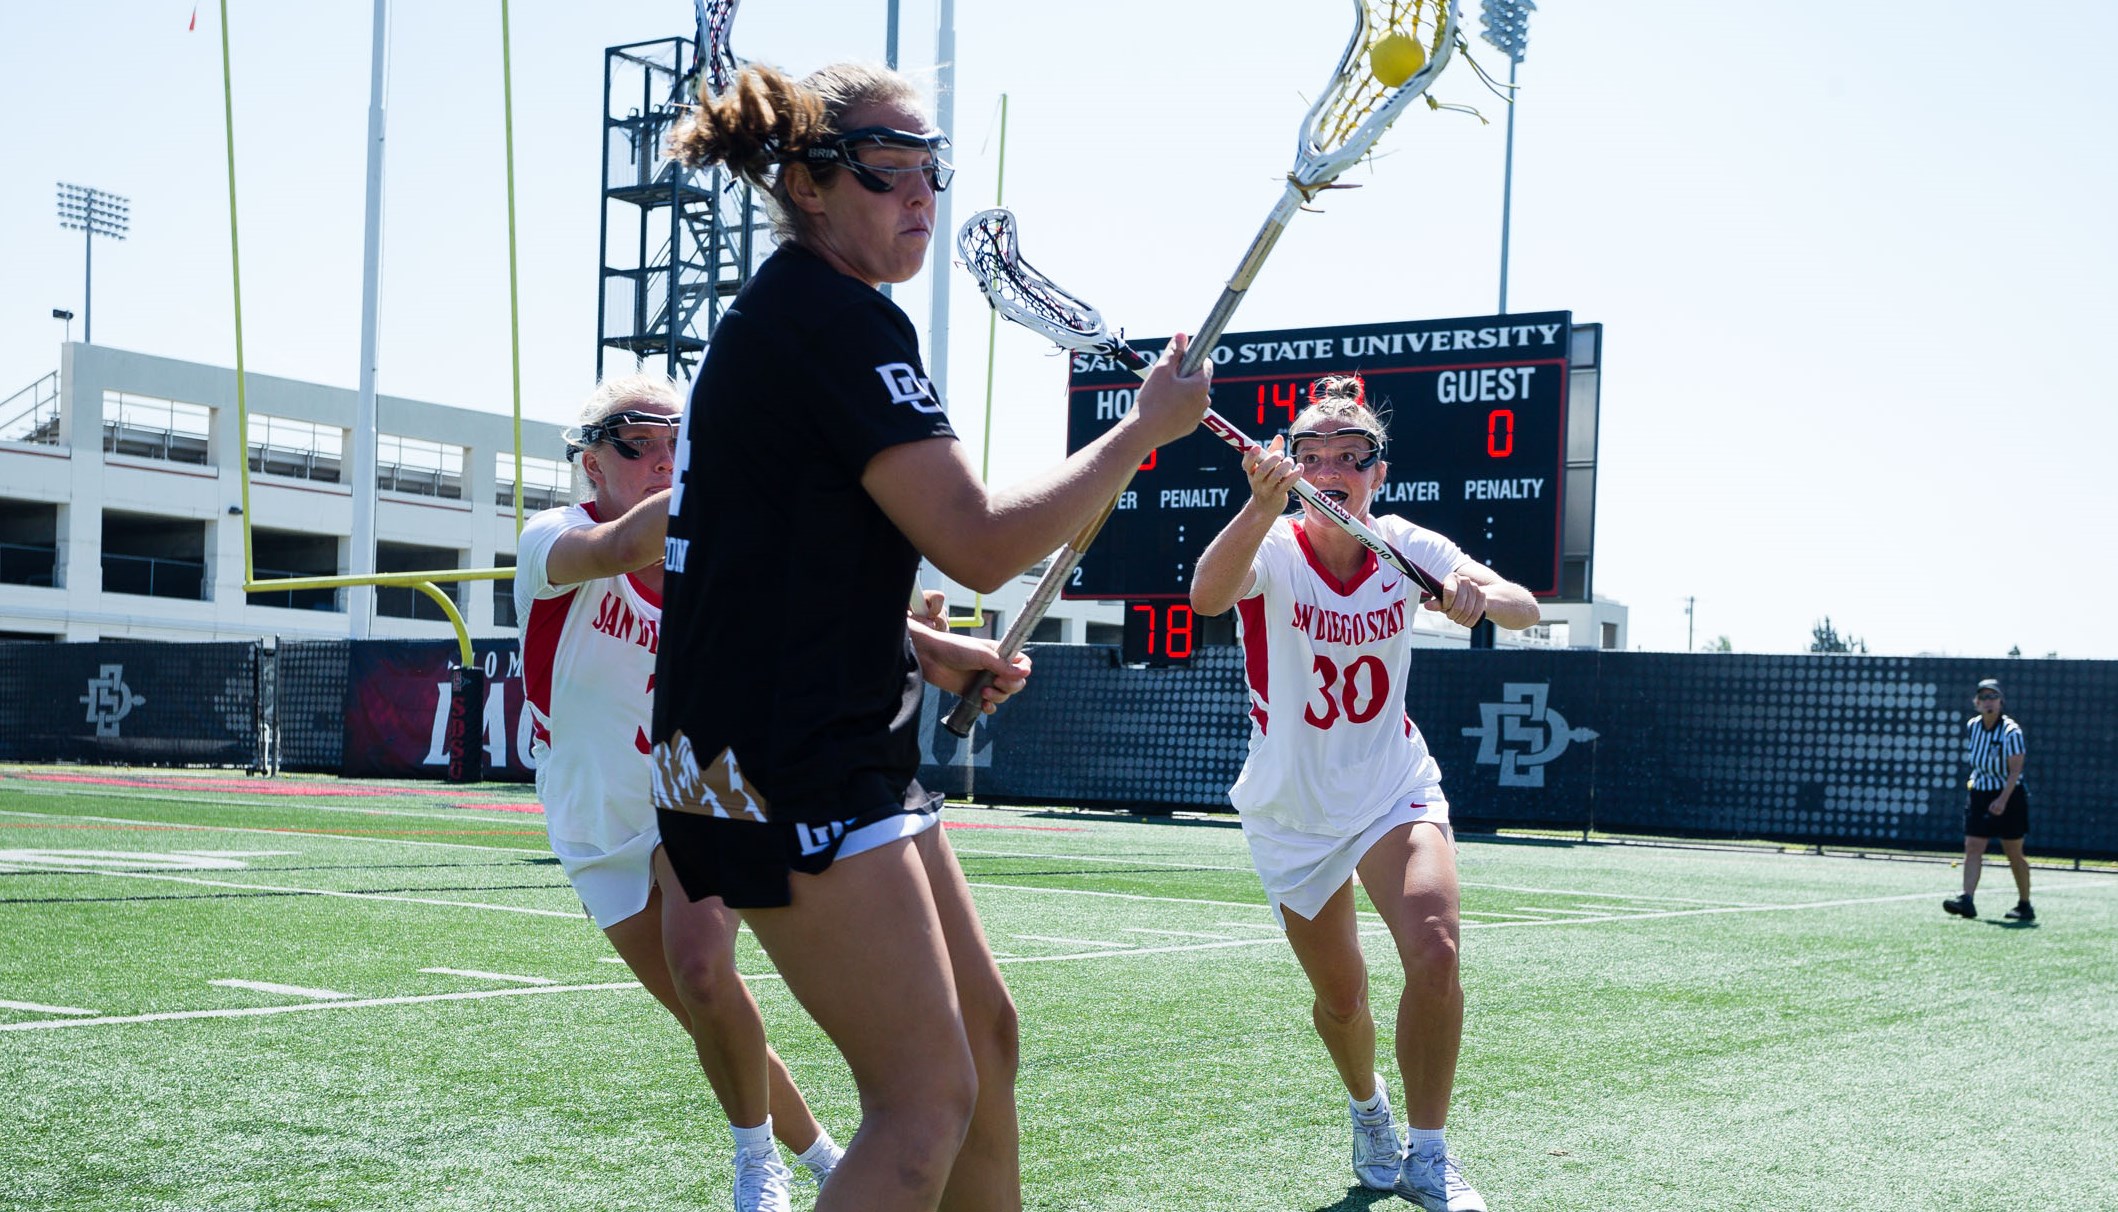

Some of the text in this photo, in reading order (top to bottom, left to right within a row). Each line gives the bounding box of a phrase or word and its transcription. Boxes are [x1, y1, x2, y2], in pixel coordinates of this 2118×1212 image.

[1239, 338, 1333, 364] STATE
[1342, 323, 1562, 357] UNIVERSITY
[1096, 388, 1138, 421] HO
[1437, 367, 1536, 404] GUEST
[1202, 414, 1254, 455] STX
[1487, 409, 1515, 458] 0
[1160, 488, 1230, 509] PENALTY
[1375, 481, 1440, 503] PLAYER
[1464, 478, 1544, 500] PENALTY
[664, 535, 691, 574] ON
[1072, 566, 1083, 587] 2
[592, 591, 635, 643] SAN
[1132, 605, 1193, 658] 78
[1315, 608, 1366, 646] DIEGO
[1367, 597, 1408, 643] STAT
[1304, 655, 1390, 731] 30
